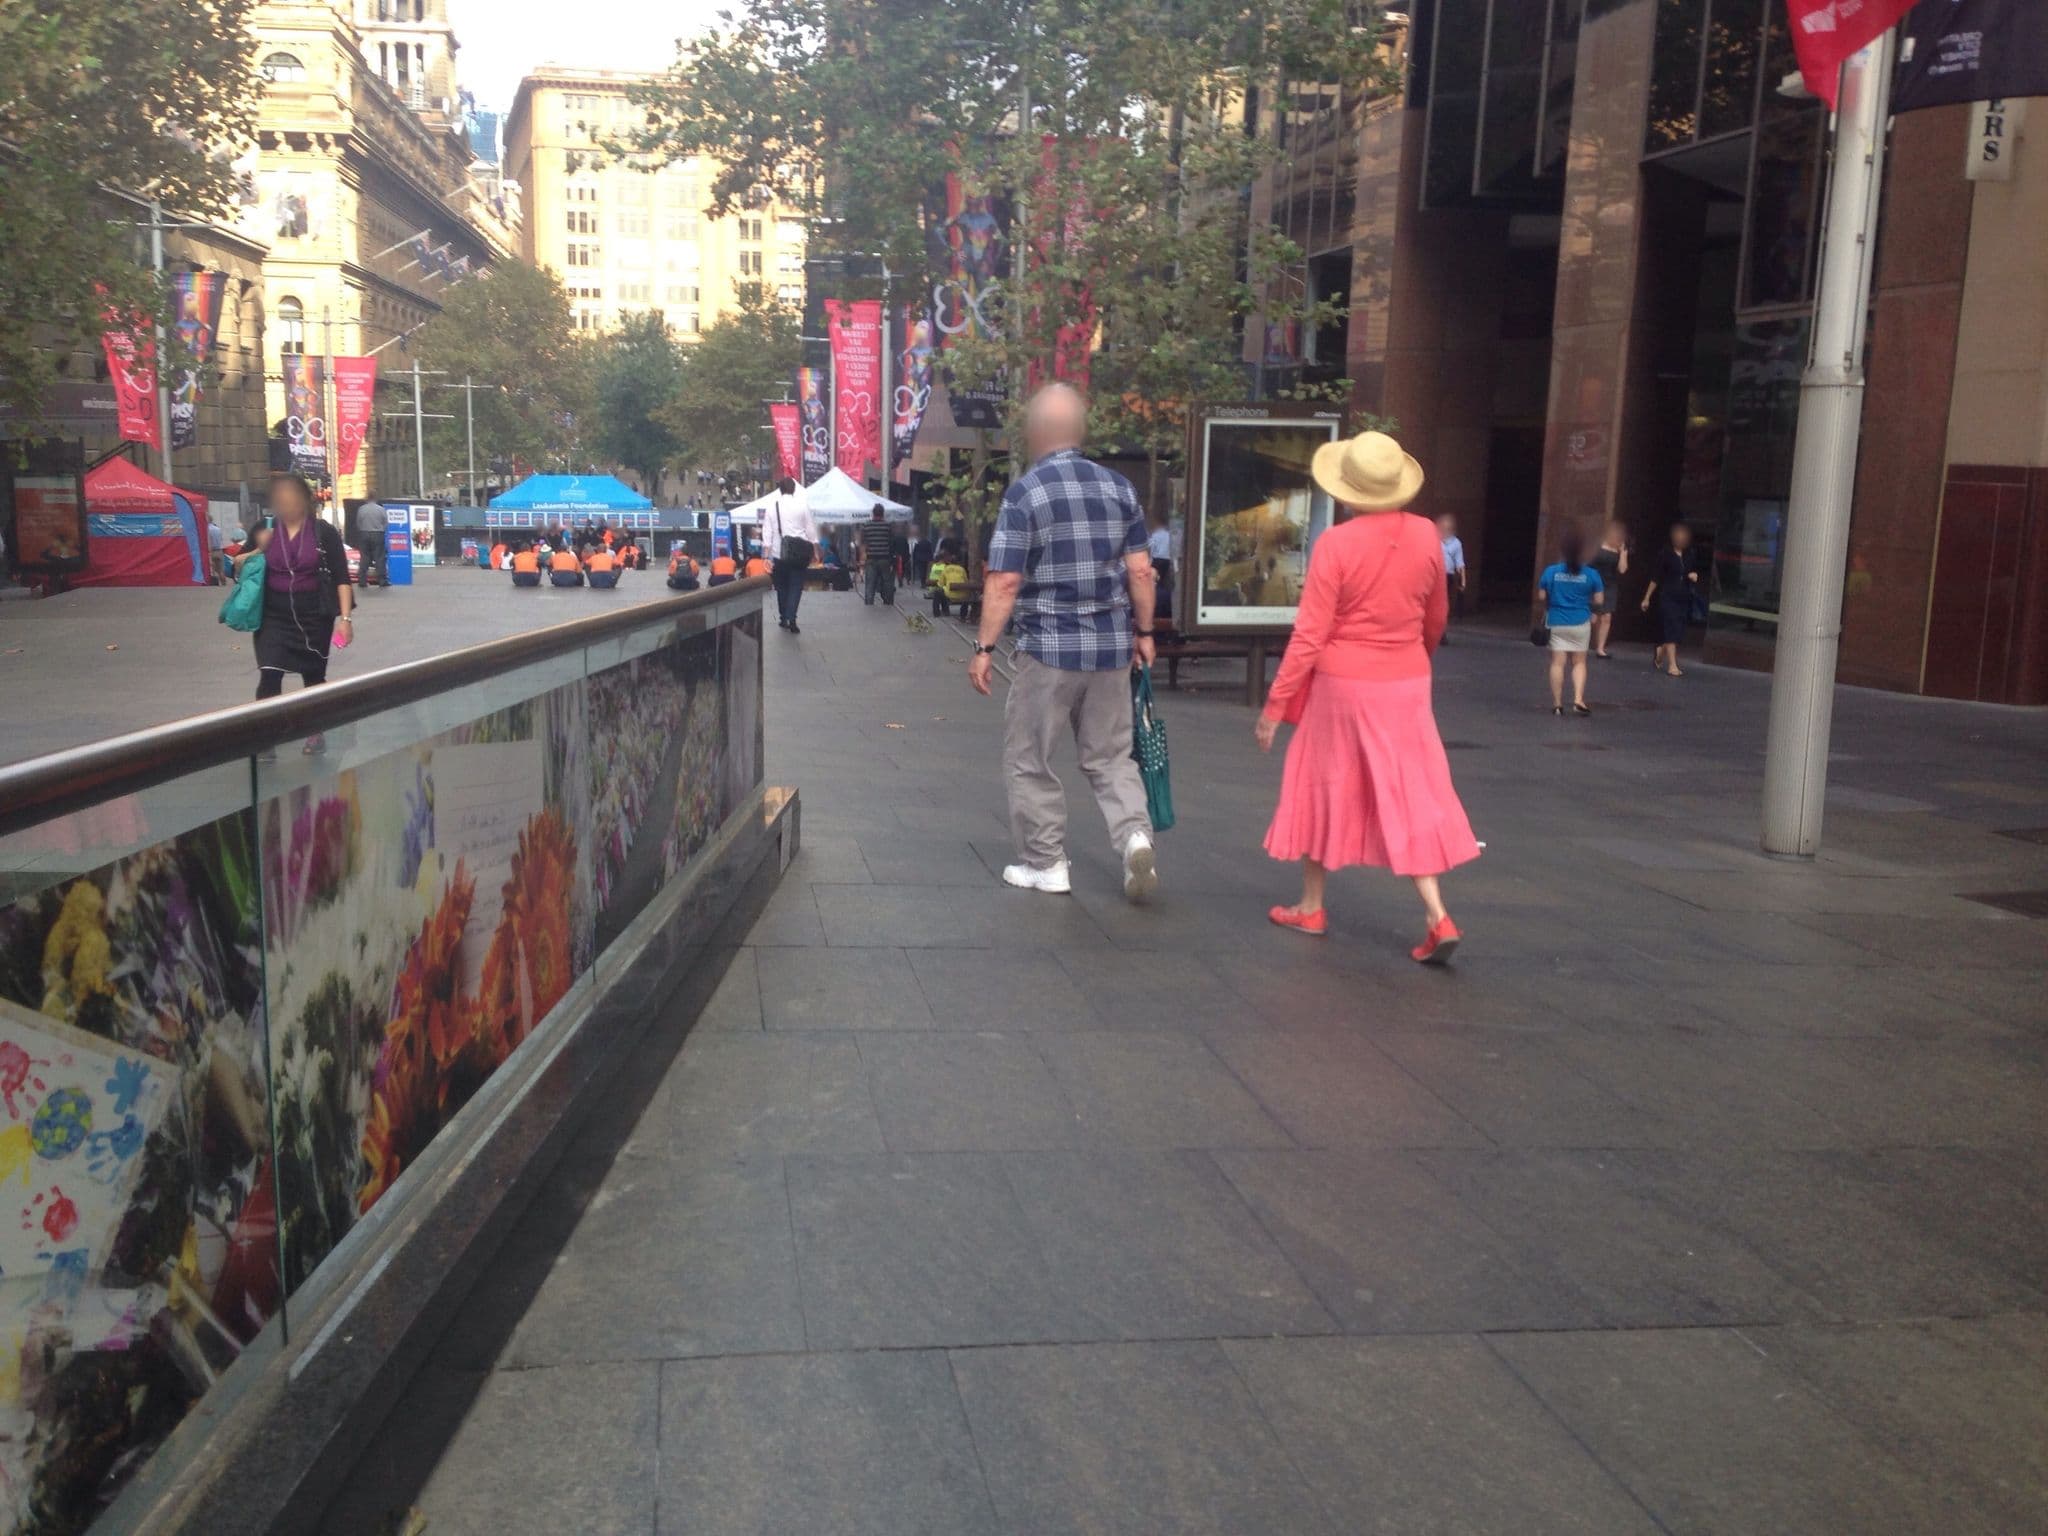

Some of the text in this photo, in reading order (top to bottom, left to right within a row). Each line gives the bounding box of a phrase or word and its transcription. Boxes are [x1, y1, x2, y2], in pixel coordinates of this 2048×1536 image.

[1214, 406, 1269, 418] Telephone
[532, 502, 609, 510] Leukaemia Foundation
